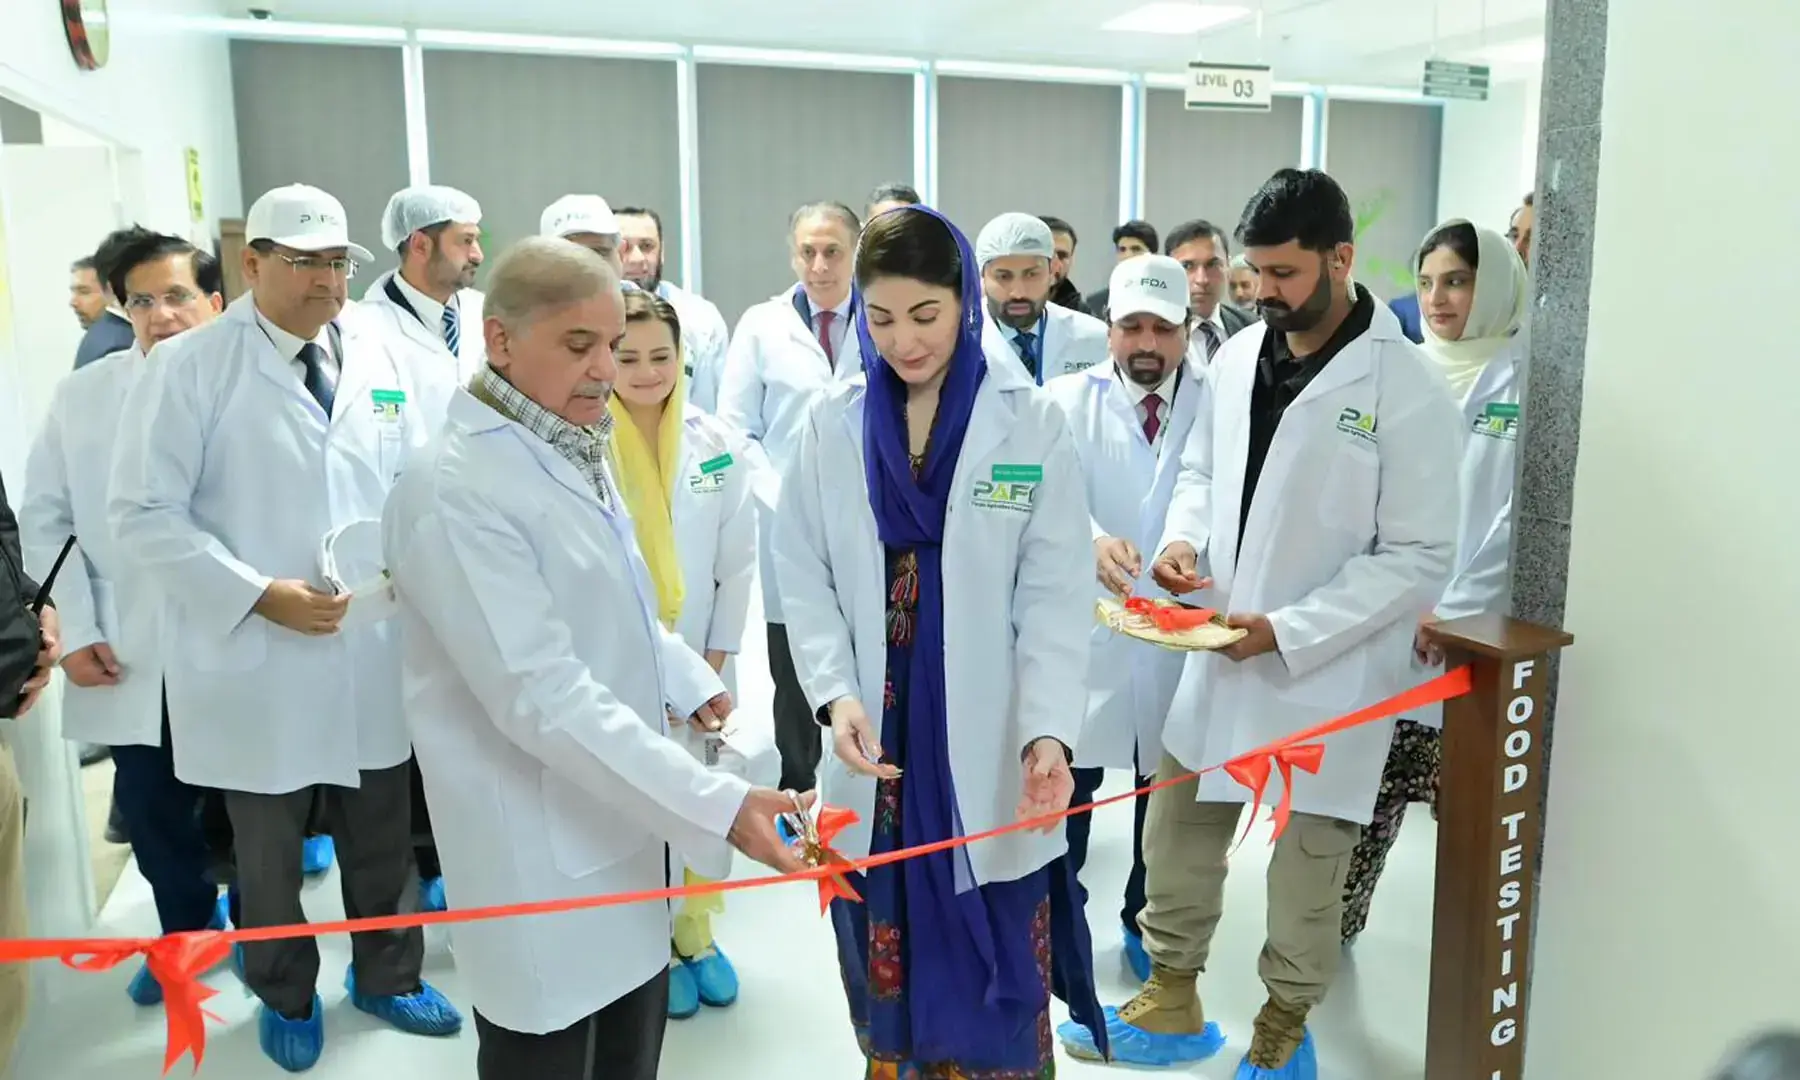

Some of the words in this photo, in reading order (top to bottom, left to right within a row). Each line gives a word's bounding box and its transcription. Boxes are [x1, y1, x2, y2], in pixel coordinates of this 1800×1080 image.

[1196, 72, 1228, 88] LEVEL
[1233, 79, 1254, 98] 03
[1504, 660, 1534, 793] FOOD
[1490, 811, 1527, 1047] TESTING
